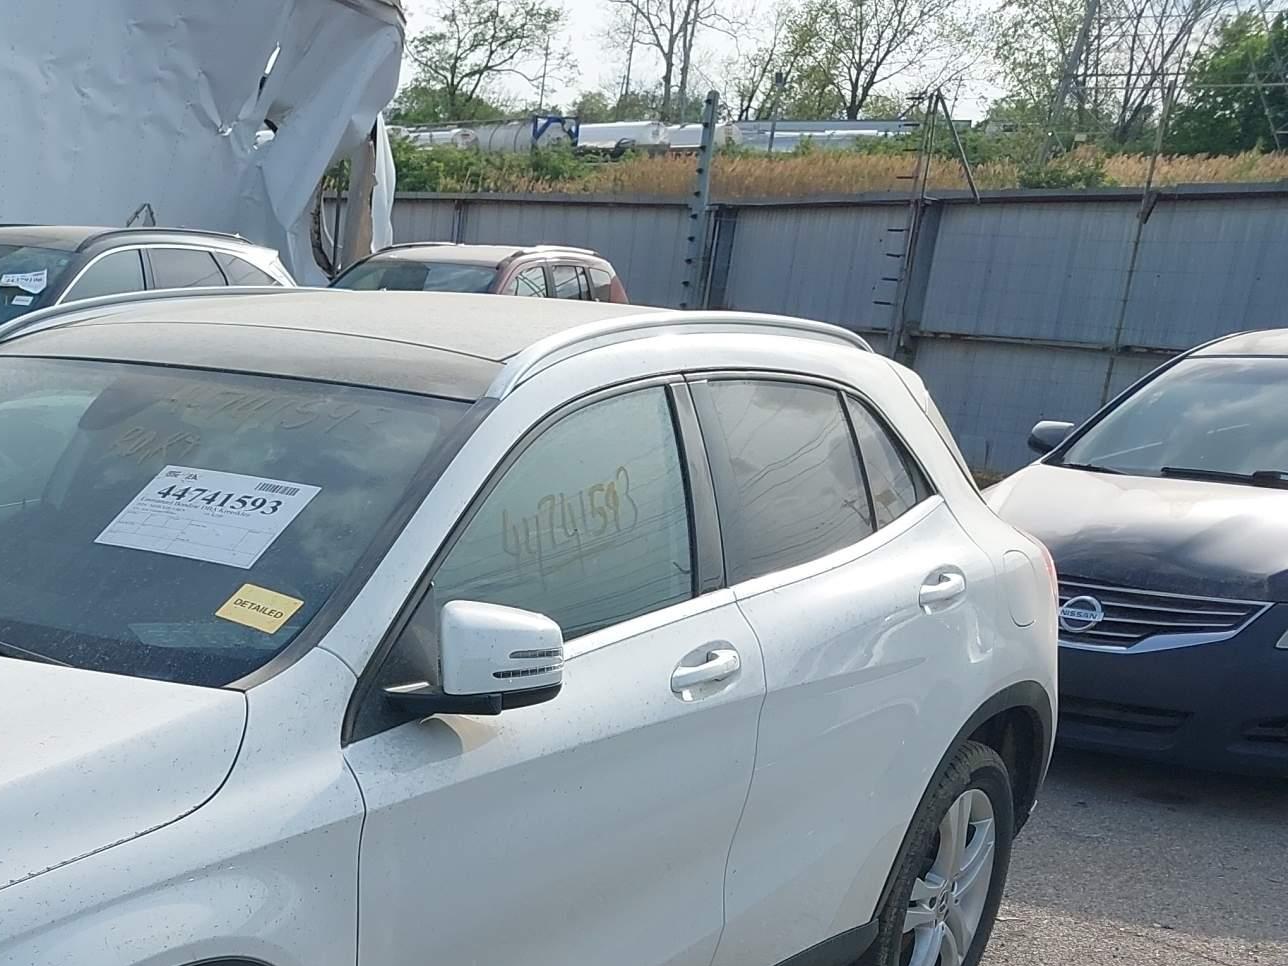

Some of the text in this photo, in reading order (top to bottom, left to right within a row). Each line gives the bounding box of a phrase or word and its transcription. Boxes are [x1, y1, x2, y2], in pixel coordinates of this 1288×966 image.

[157, 485, 282, 515] 44741593
[233, 598, 284, 619] DETAILED
[1062, 608, 1098, 620] NISSAN
